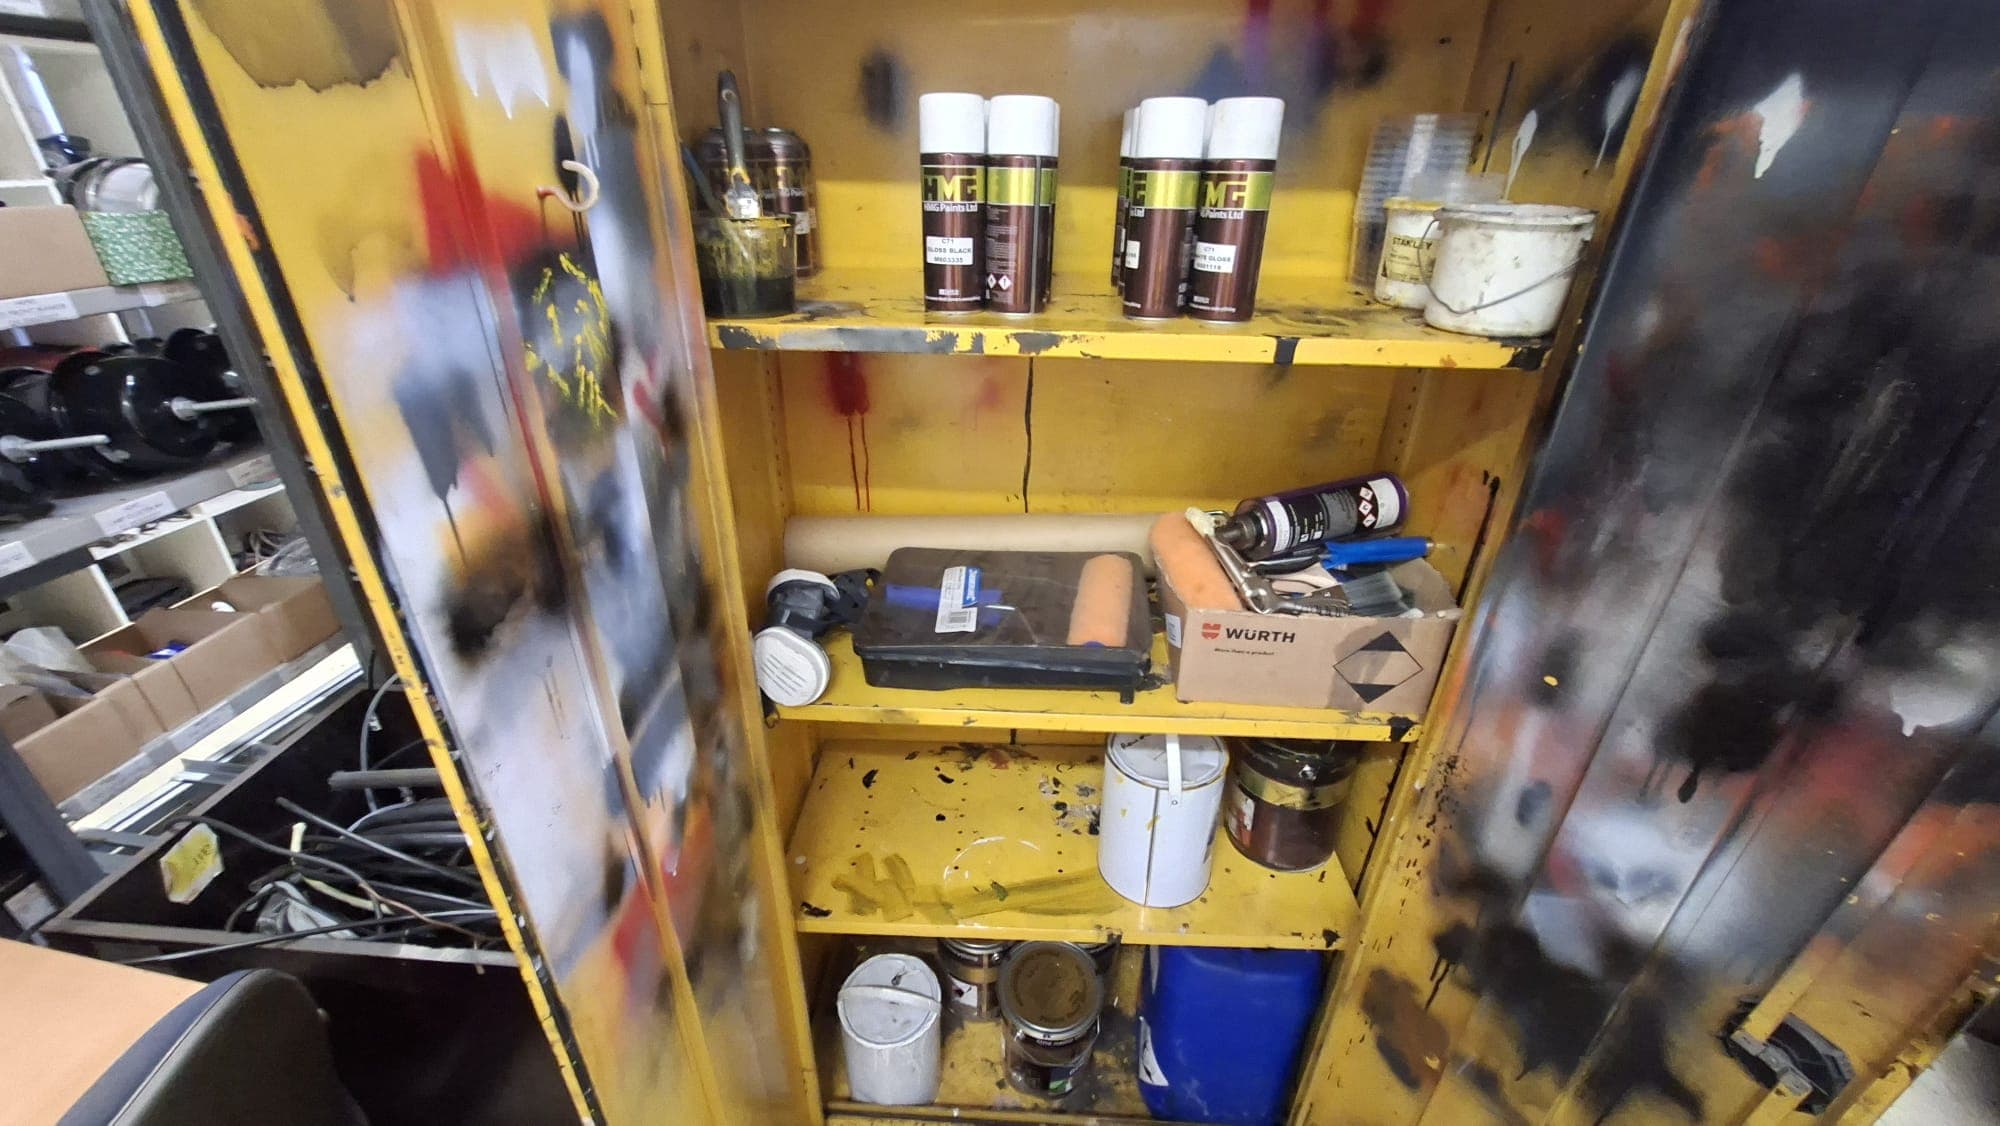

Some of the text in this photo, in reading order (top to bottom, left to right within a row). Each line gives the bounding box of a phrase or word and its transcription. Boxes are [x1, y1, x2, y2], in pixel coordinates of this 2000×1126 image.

[924, 175, 977, 202] HMG
[1201, 180, 1245, 209] MG
[940, 202, 965, 213] Paints
[1226, 627, 1296, 644] WÜRTH
